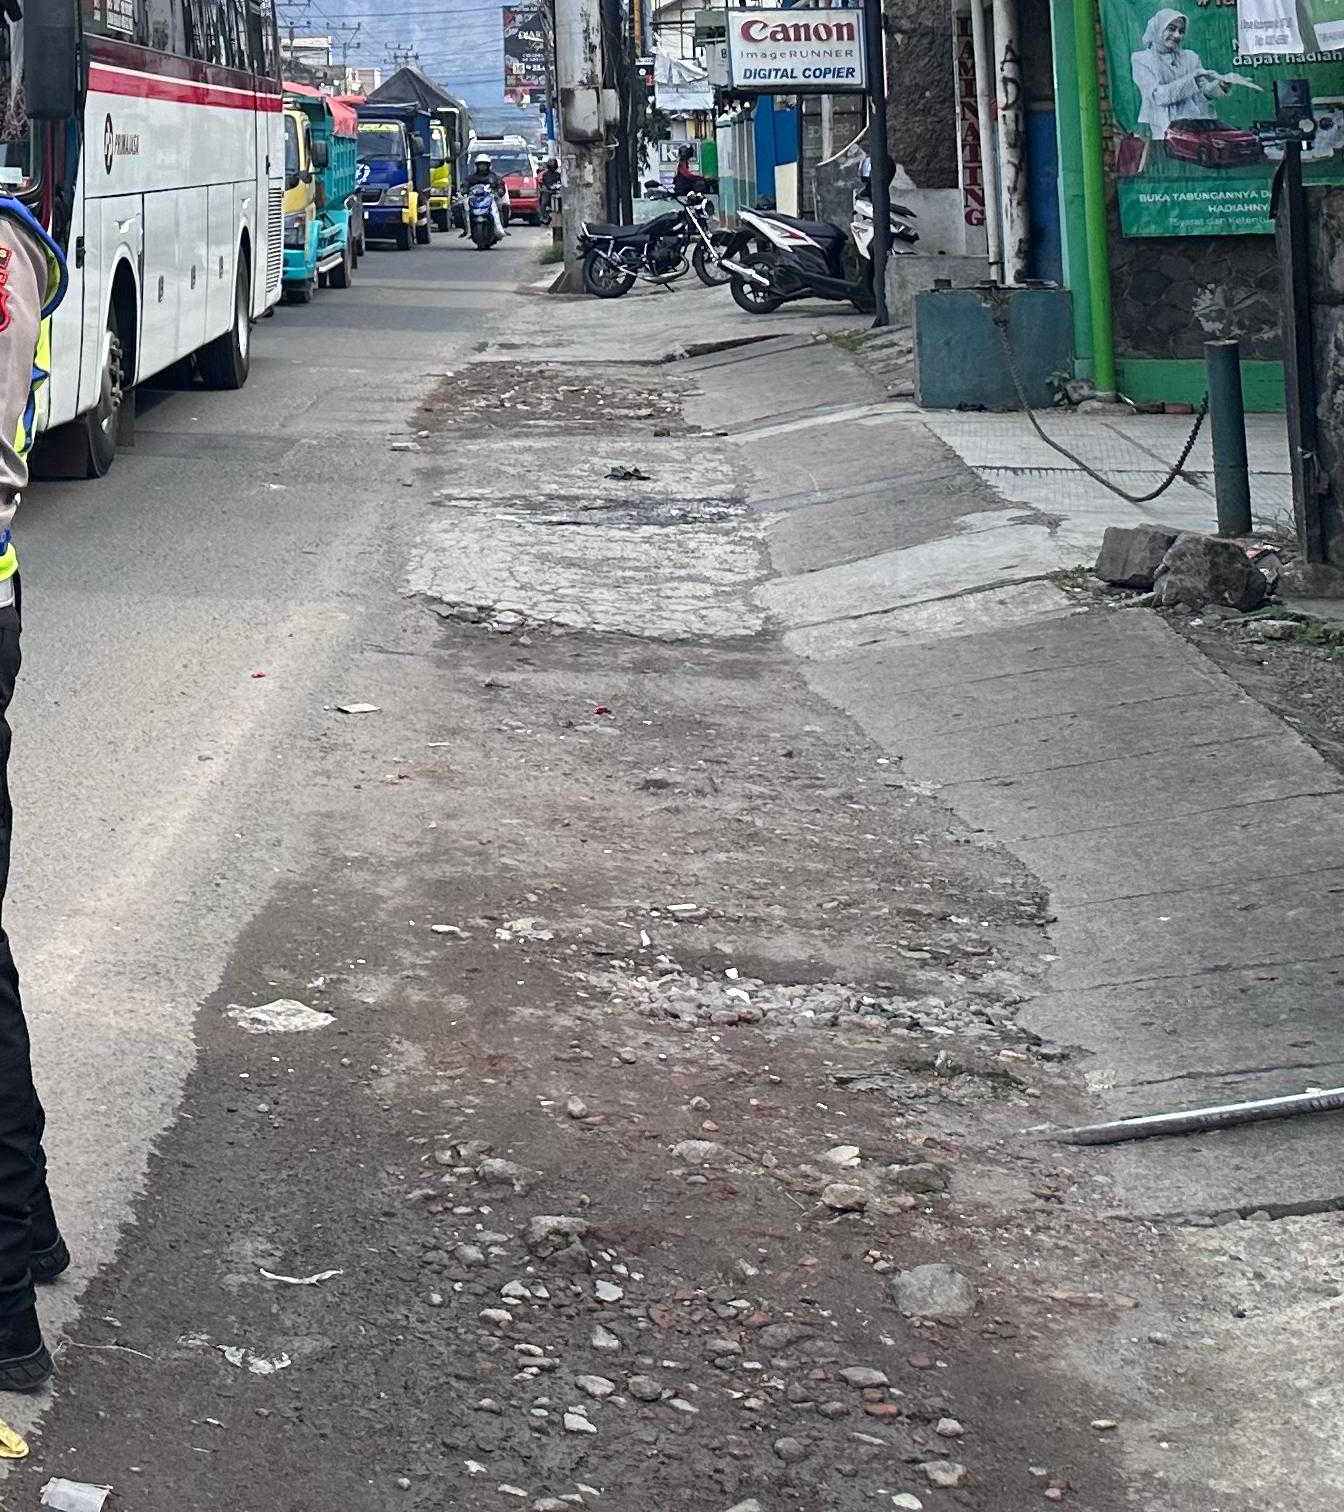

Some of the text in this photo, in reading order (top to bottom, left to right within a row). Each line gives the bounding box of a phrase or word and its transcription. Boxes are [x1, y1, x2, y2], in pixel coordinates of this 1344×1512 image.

[740, 19, 855, 43] Canon
[1232, 53, 1281, 67] dapat
[742, 66, 856, 80] DIGITAL COPIER
[1139, 193, 1171, 203] BUKA
[1172, 190, 1259, 202] TABUNGANNYA
[1208, 203, 1271, 213] HADIAHNY
